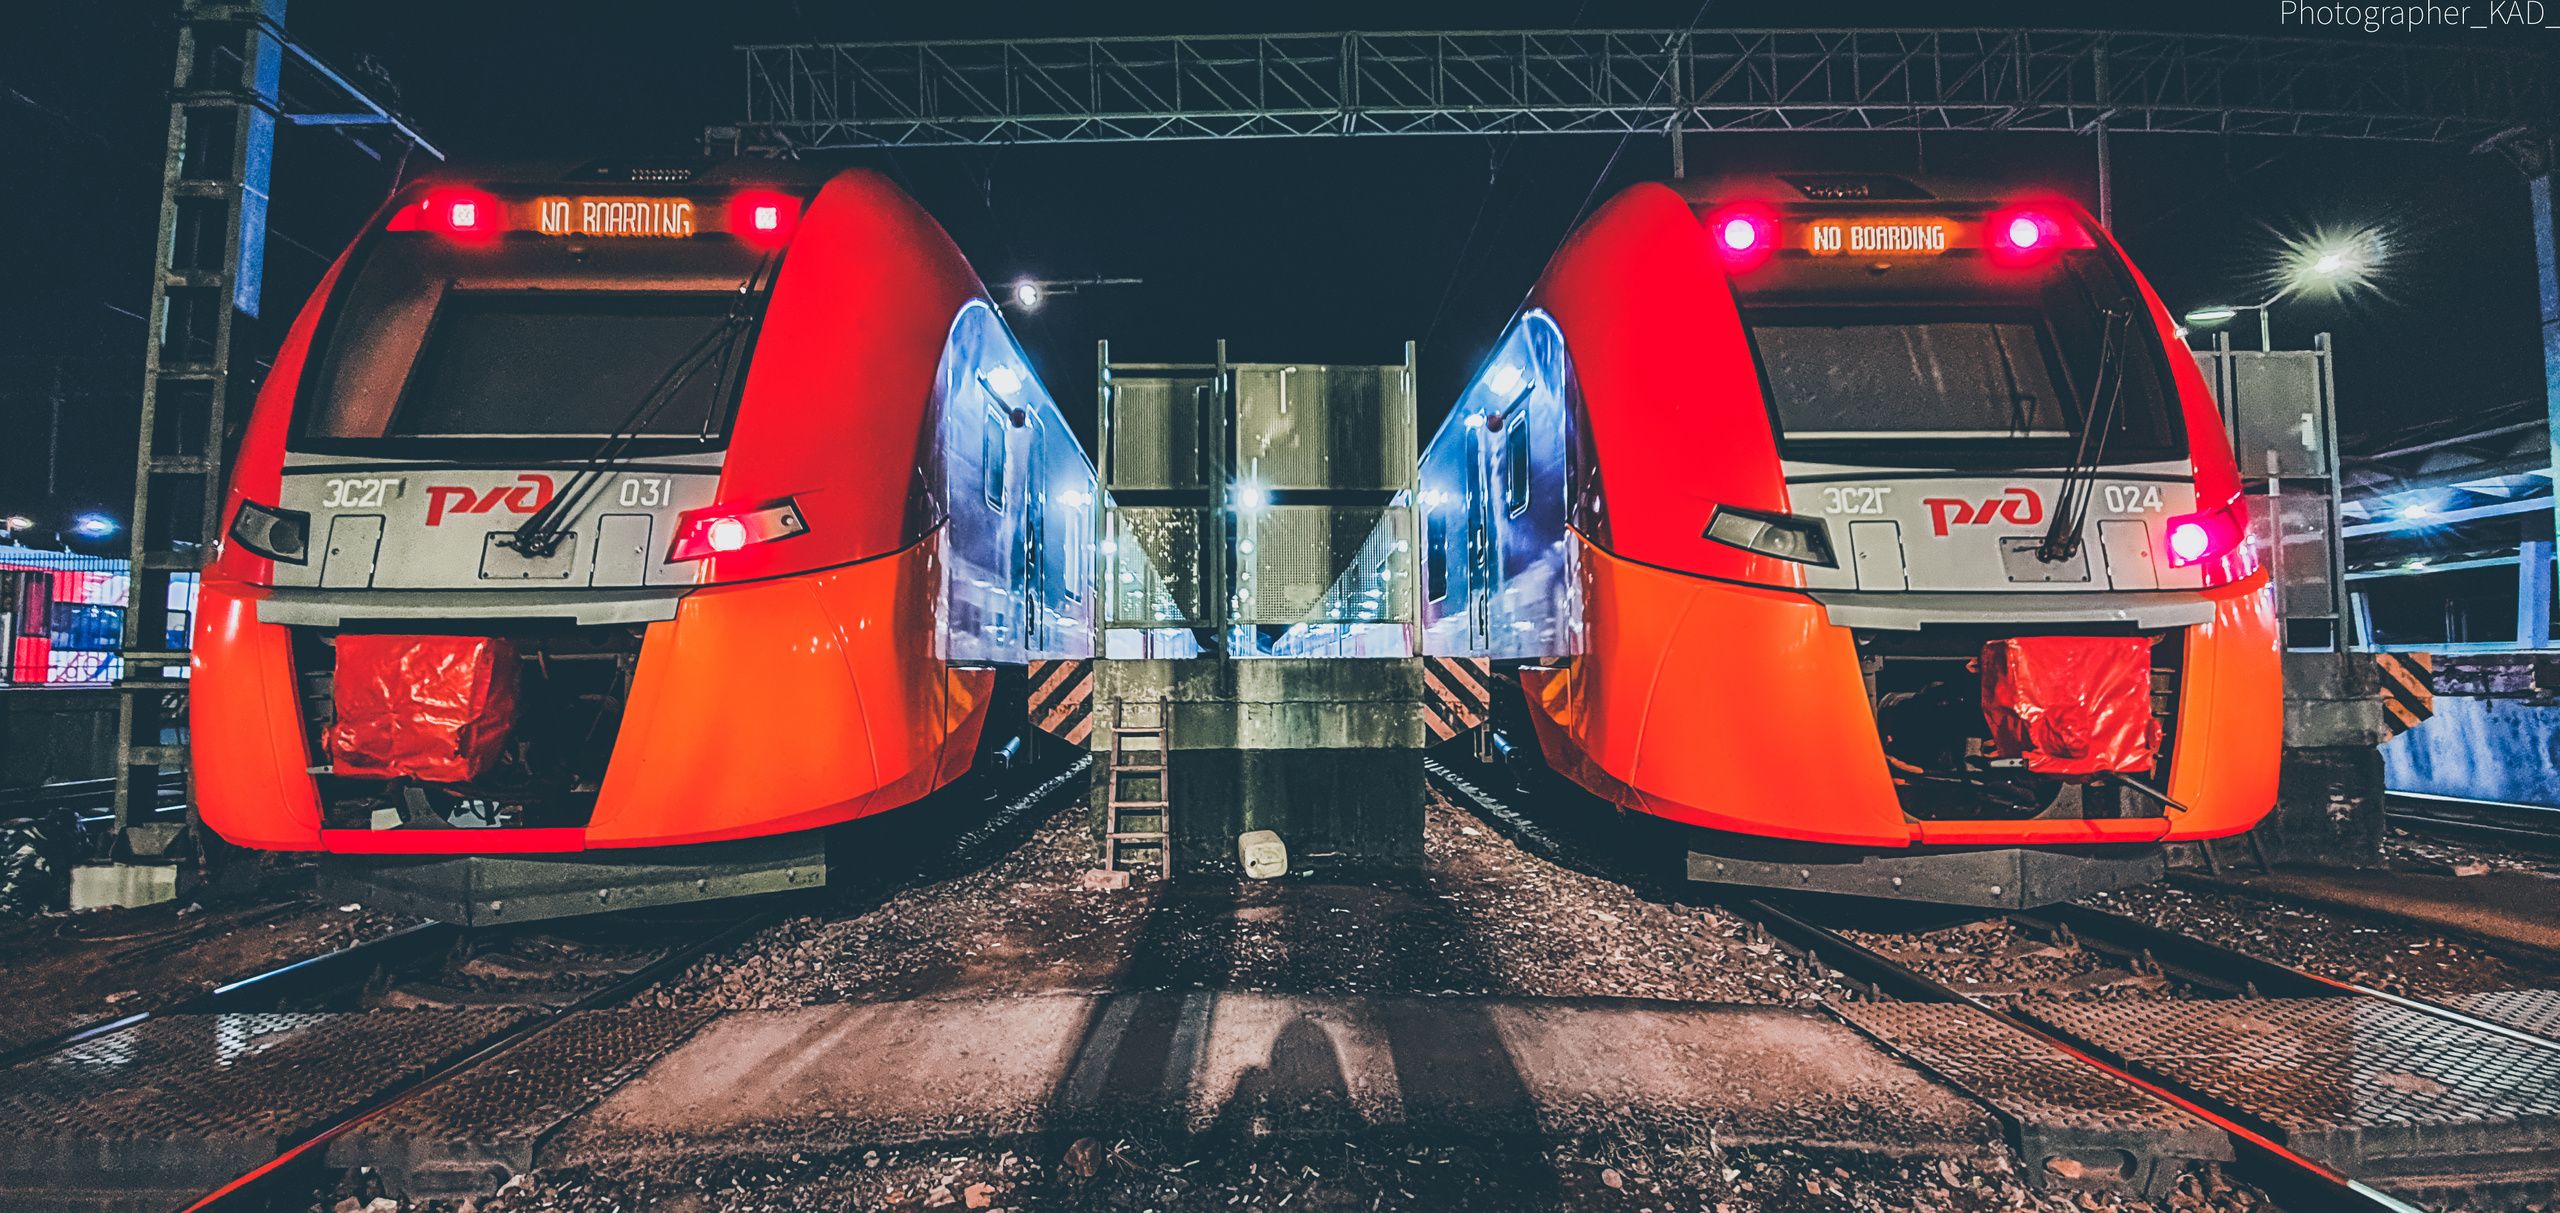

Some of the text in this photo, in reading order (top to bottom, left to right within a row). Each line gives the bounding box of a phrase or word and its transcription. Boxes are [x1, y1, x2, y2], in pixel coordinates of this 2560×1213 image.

[1814, 226, 1945, 250] NO BOARDING
[619, 478, 672, 507] 031
[2104, 486, 2163, 513] 024
